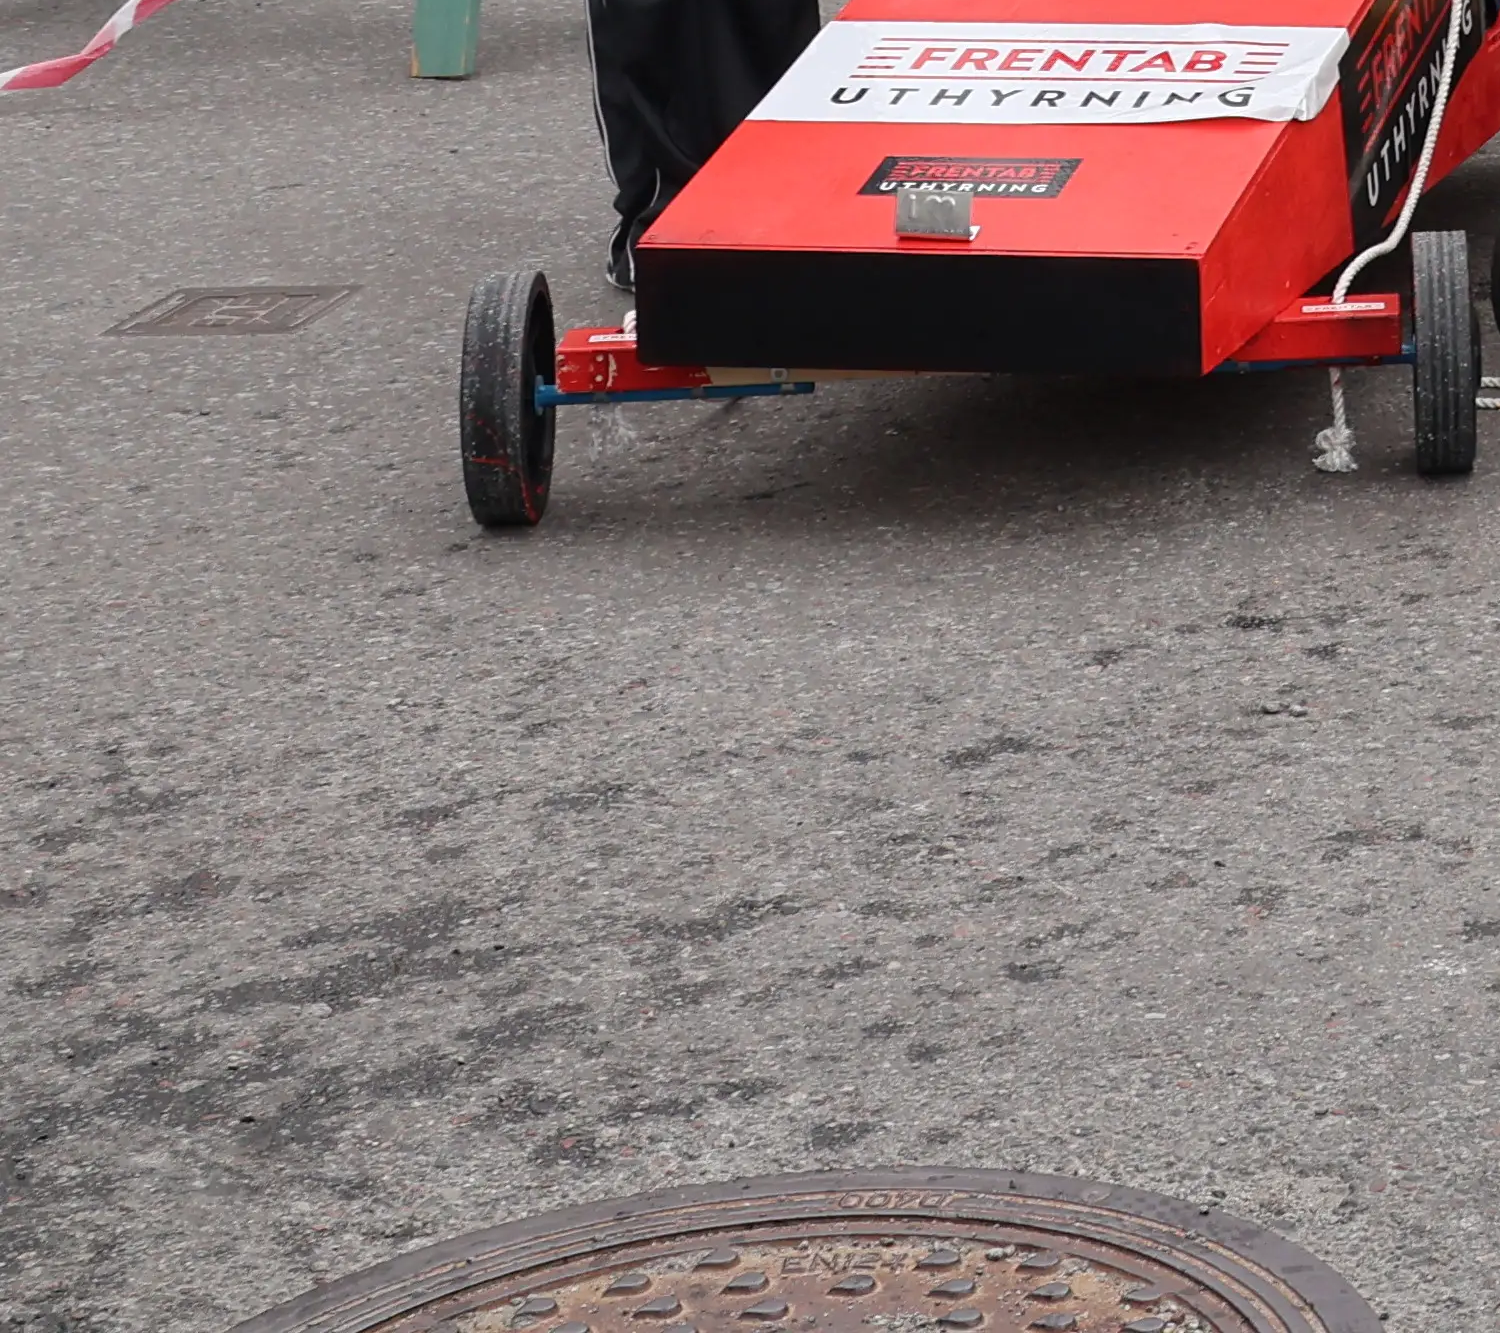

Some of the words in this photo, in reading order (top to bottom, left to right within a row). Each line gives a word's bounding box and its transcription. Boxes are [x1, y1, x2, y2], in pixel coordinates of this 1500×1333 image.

[908, 47, 1227, 73] FRENTAB
[830, 86, 1257, 109] UTHYRNING
[908, 163, 1038, 180] FRENTAB
[879, 181, 1050, 194] UTHYRNING
